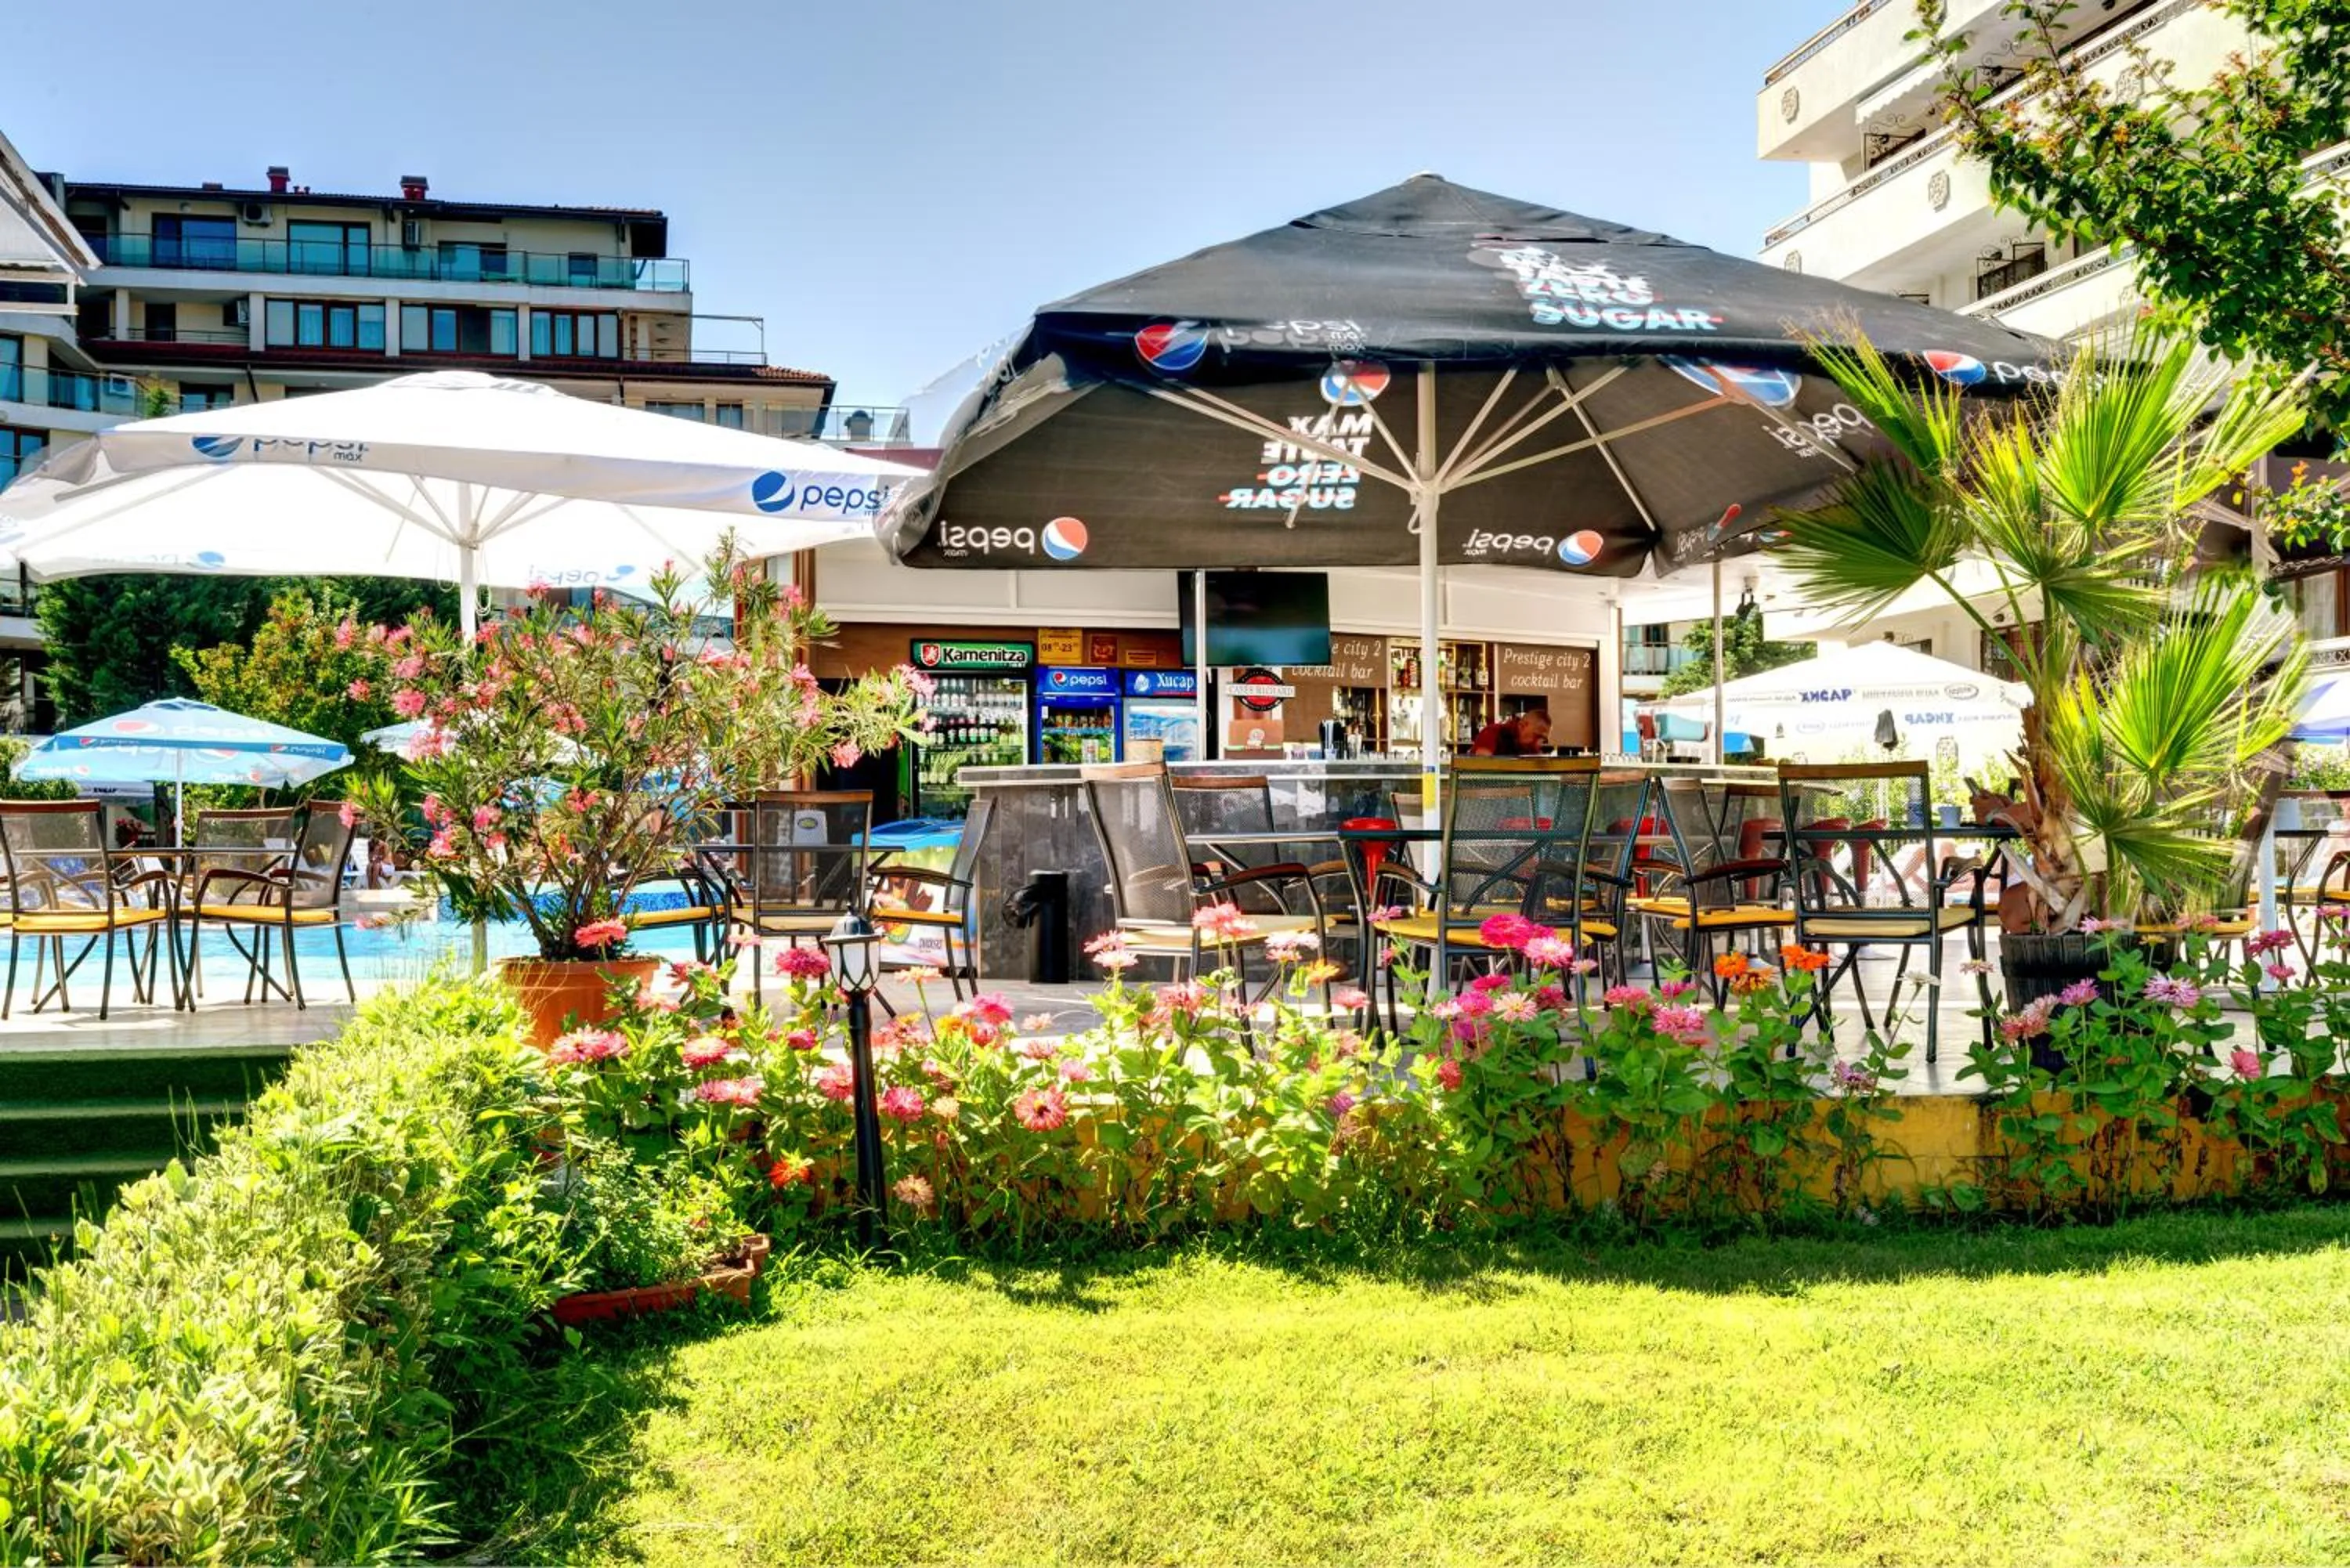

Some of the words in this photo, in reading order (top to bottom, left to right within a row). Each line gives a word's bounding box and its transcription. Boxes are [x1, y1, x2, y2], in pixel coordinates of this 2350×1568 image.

[1531, 301, 1719, 330] SUGAR
[334, 451, 363, 461] max
[800, 485, 890, 515] pepsi
[942, 647, 1028, 664] Kamenitza
[1343, 641, 1368, 658] city
[1373, 640, 1382, 656] 2
[1503, 648, 1553, 670] Prestige
[1556, 652, 1578, 671] city
[1582, 652, 1591, 668] 2
[1292, 663, 1345, 677] cocktail
[1352, 663, 1373, 679] bar
[1070, 674, 1107, 686] pepsi
[1156, 672, 1196, 688] Хисар
[1510, 672, 1558, 688] cocktail
[1563, 674, 1582, 689] bar
